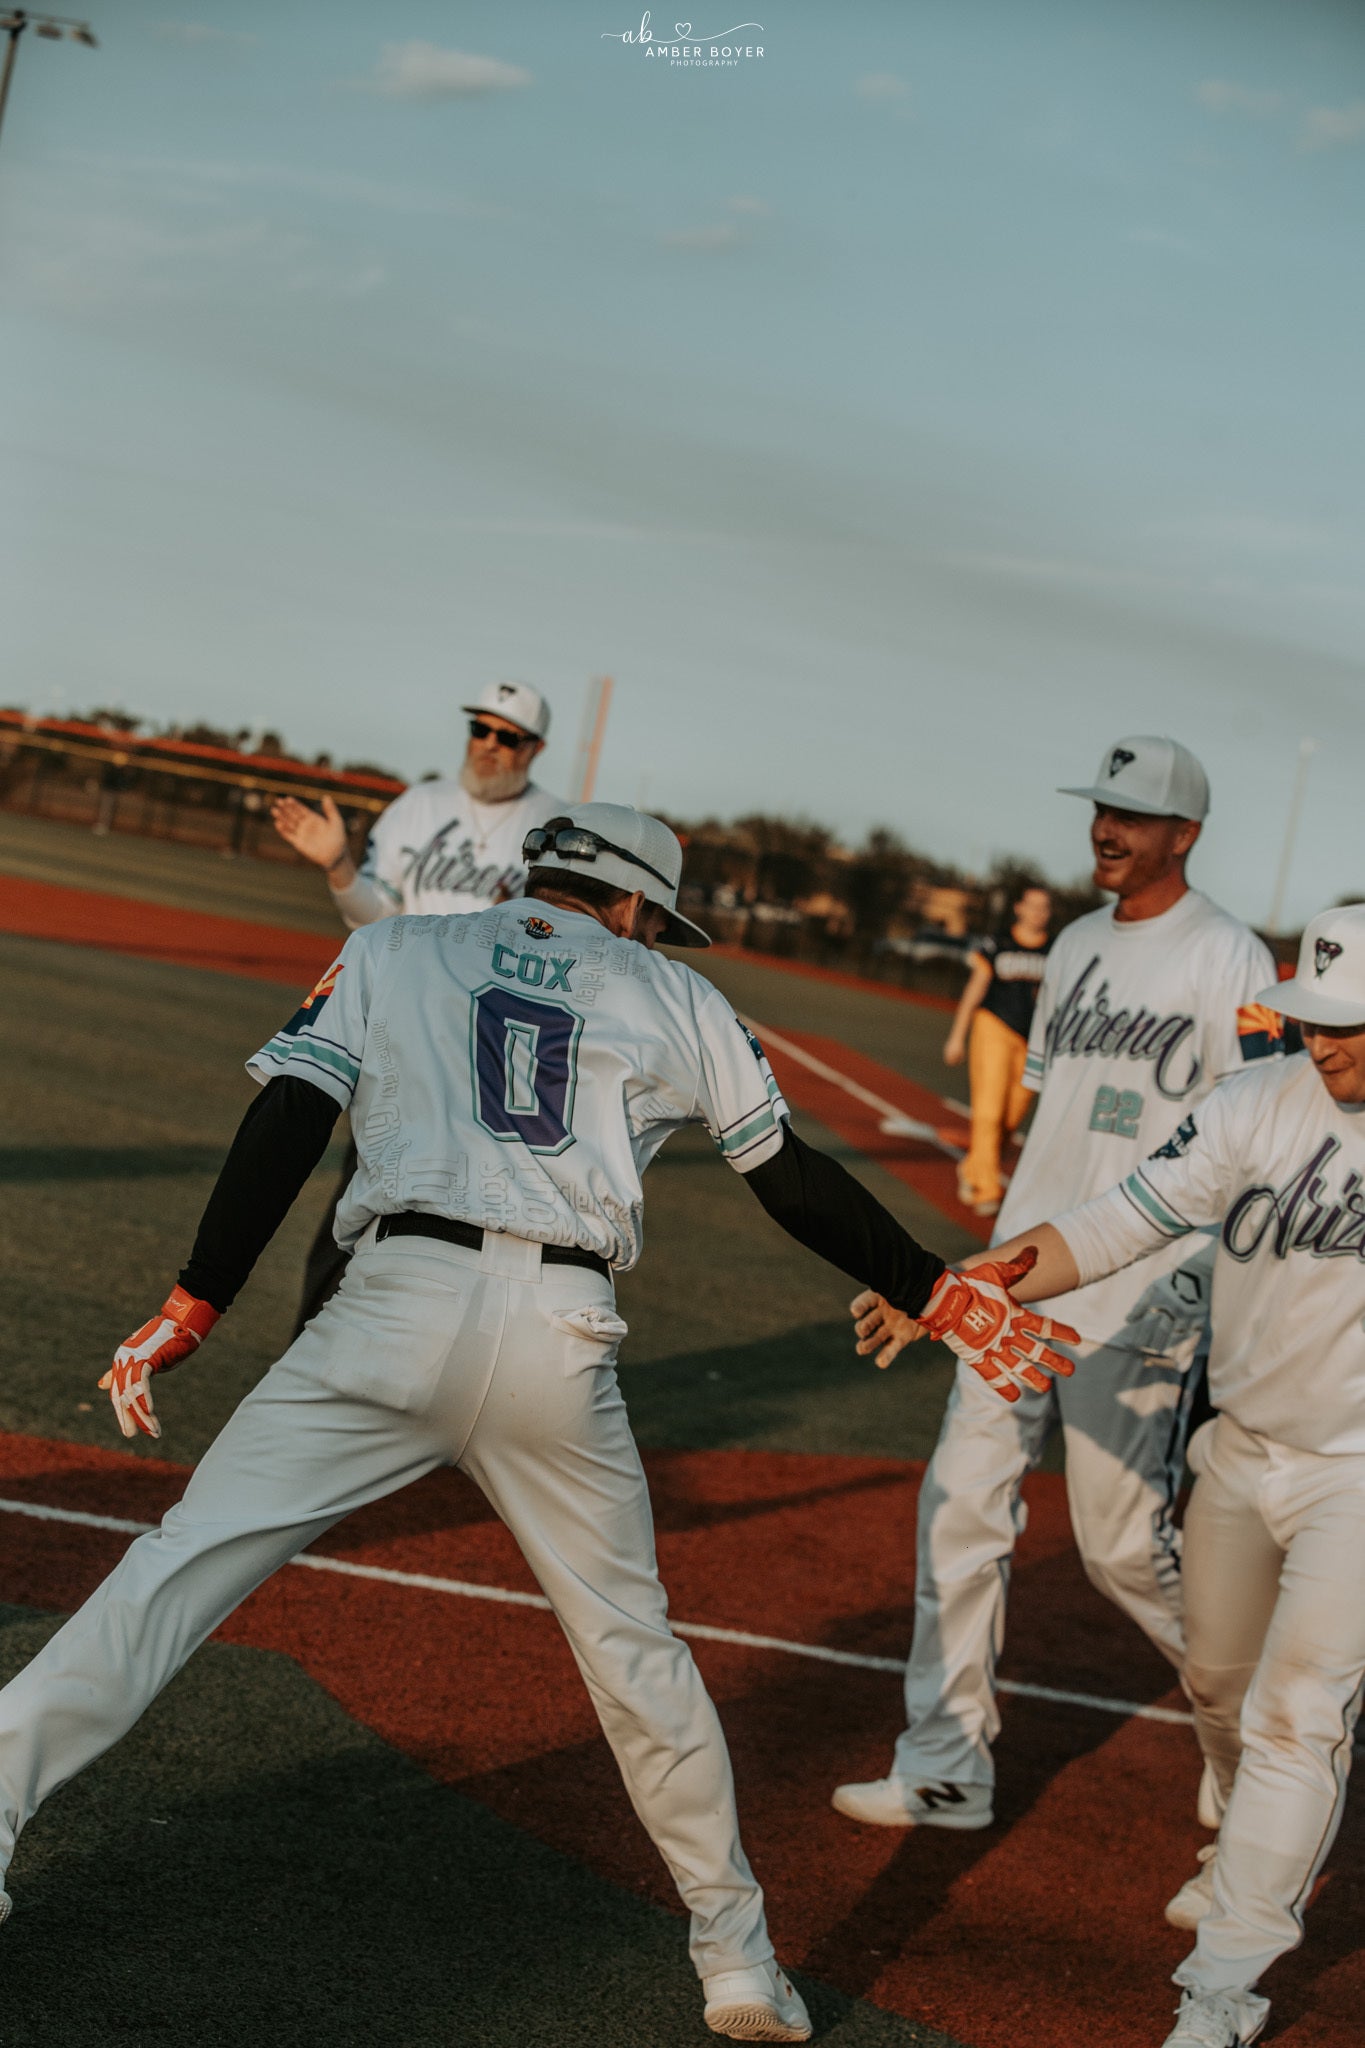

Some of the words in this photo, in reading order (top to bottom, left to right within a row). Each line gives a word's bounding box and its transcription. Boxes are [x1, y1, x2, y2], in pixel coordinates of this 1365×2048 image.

[491, 943, 577, 992] COX
[470, 981, 585, 1156] 0
[1046, 954, 1201, 1100] Arizona
[379, 1072, 401, 1098] City
[1088, 1085, 1145, 1139] 22
[1222, 1133, 1365, 1263] Ariz
